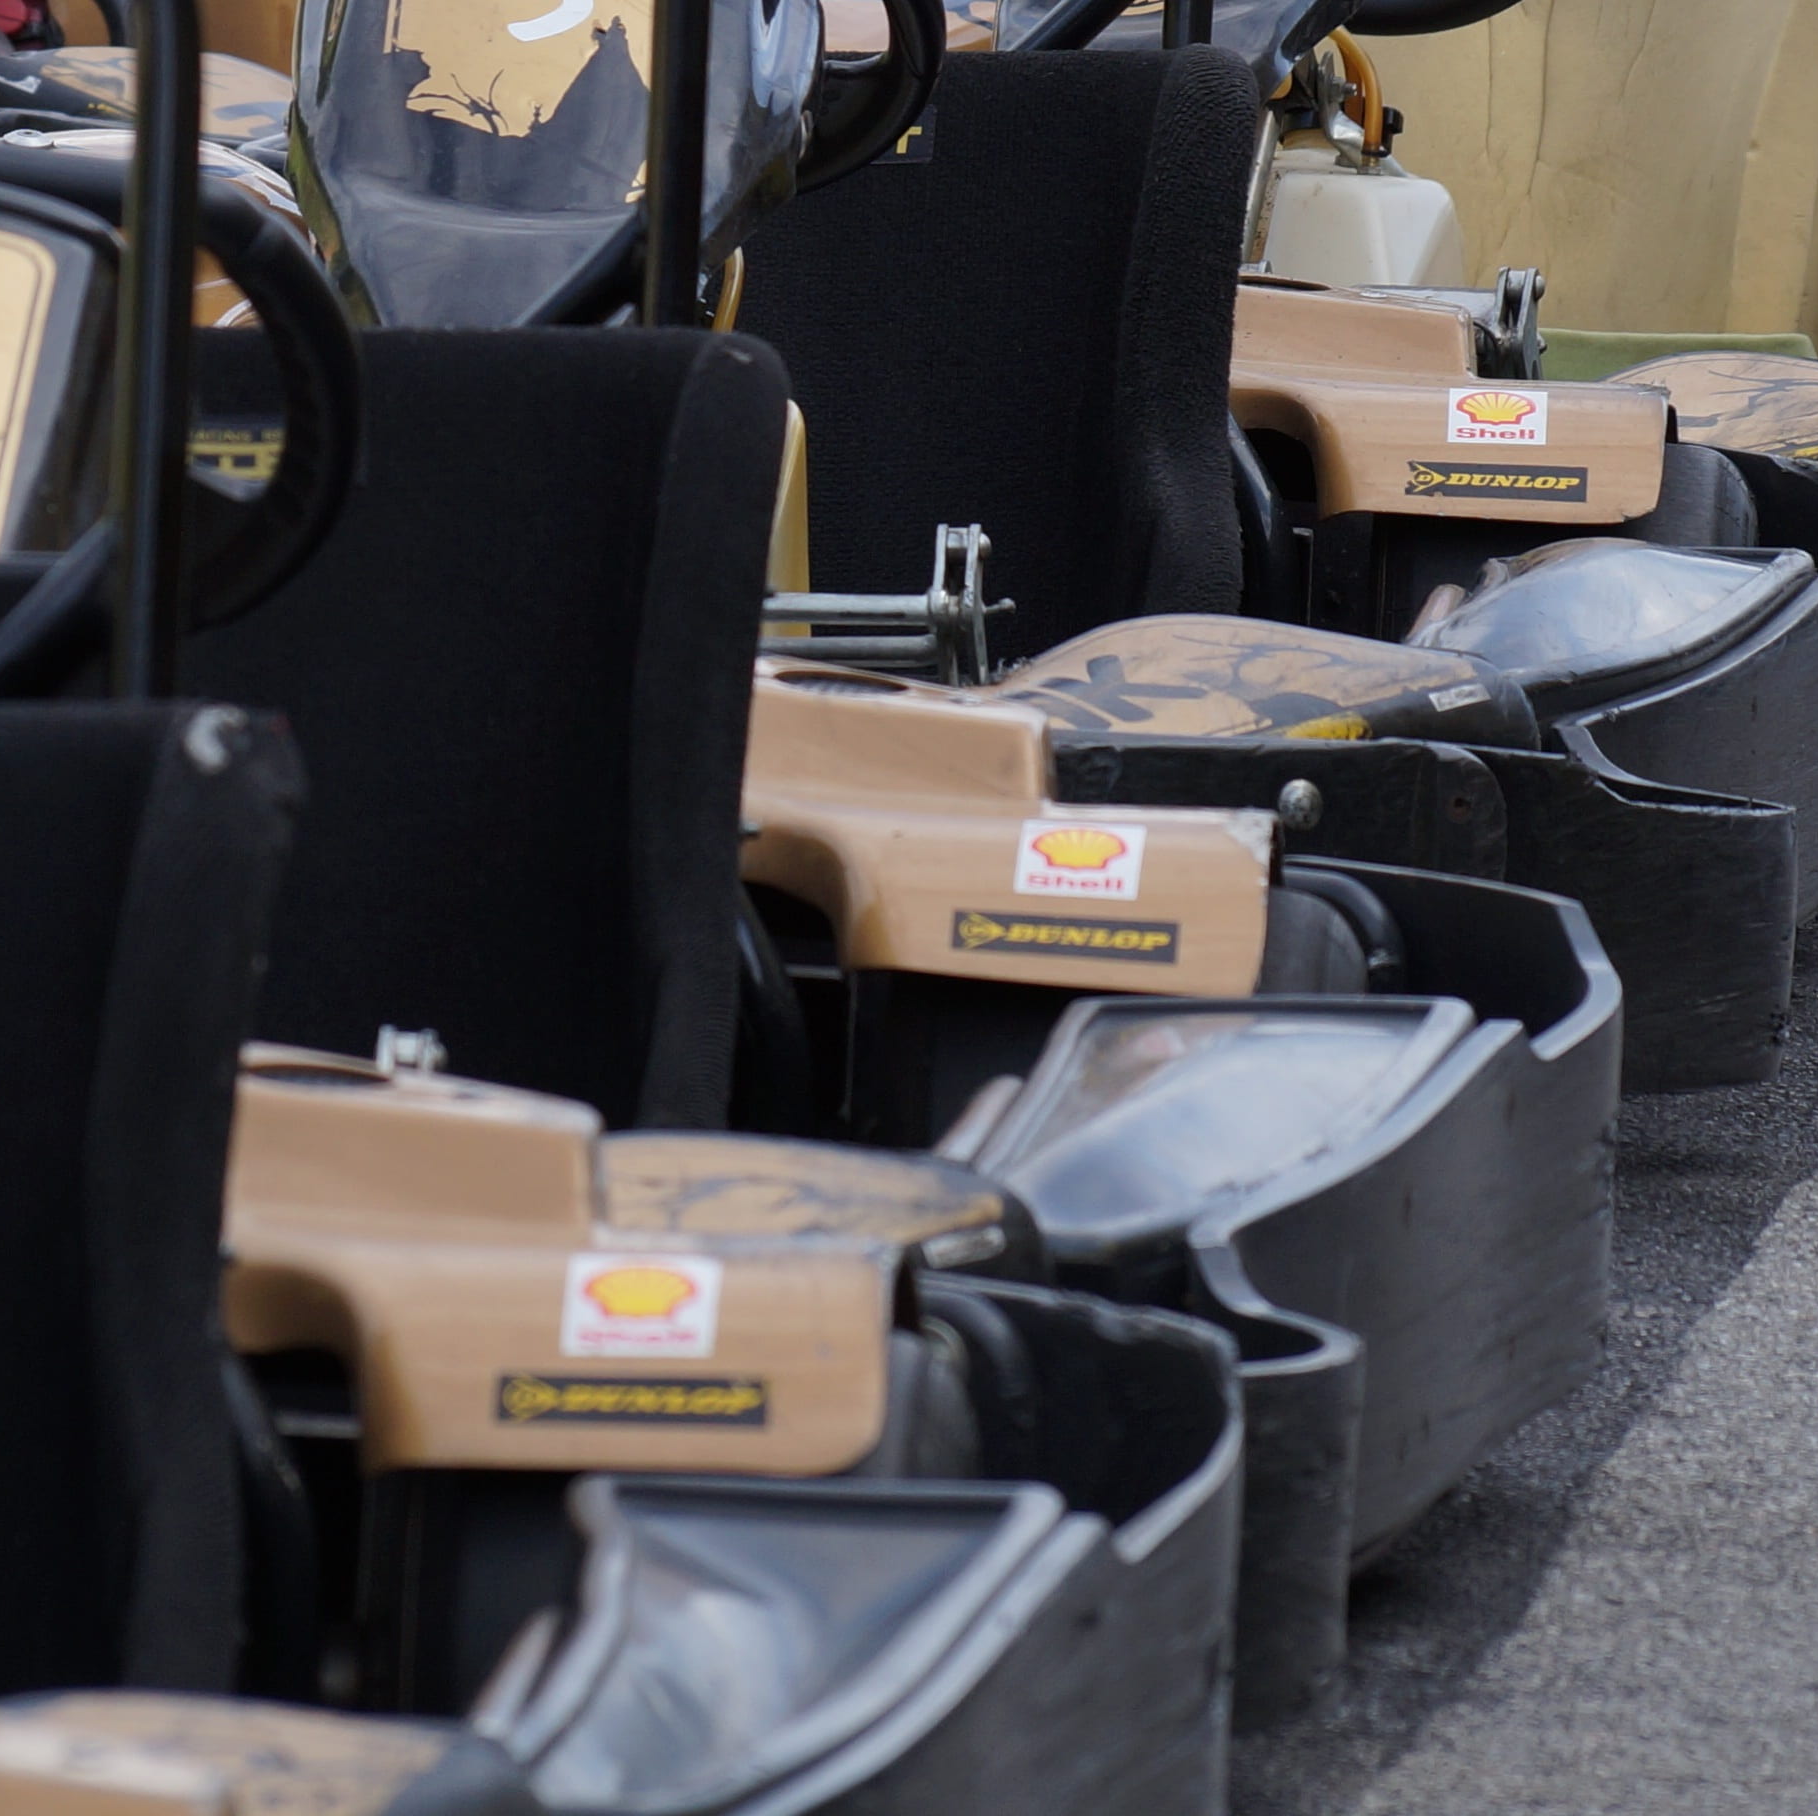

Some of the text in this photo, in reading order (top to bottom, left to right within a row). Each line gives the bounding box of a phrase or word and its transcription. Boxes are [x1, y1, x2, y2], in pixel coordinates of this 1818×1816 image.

[1456, 427, 1536, 440] Shell
[1445, 472, 1581, 490] DUNLOP
[1004, 922, 1172, 951] DUNLOP
